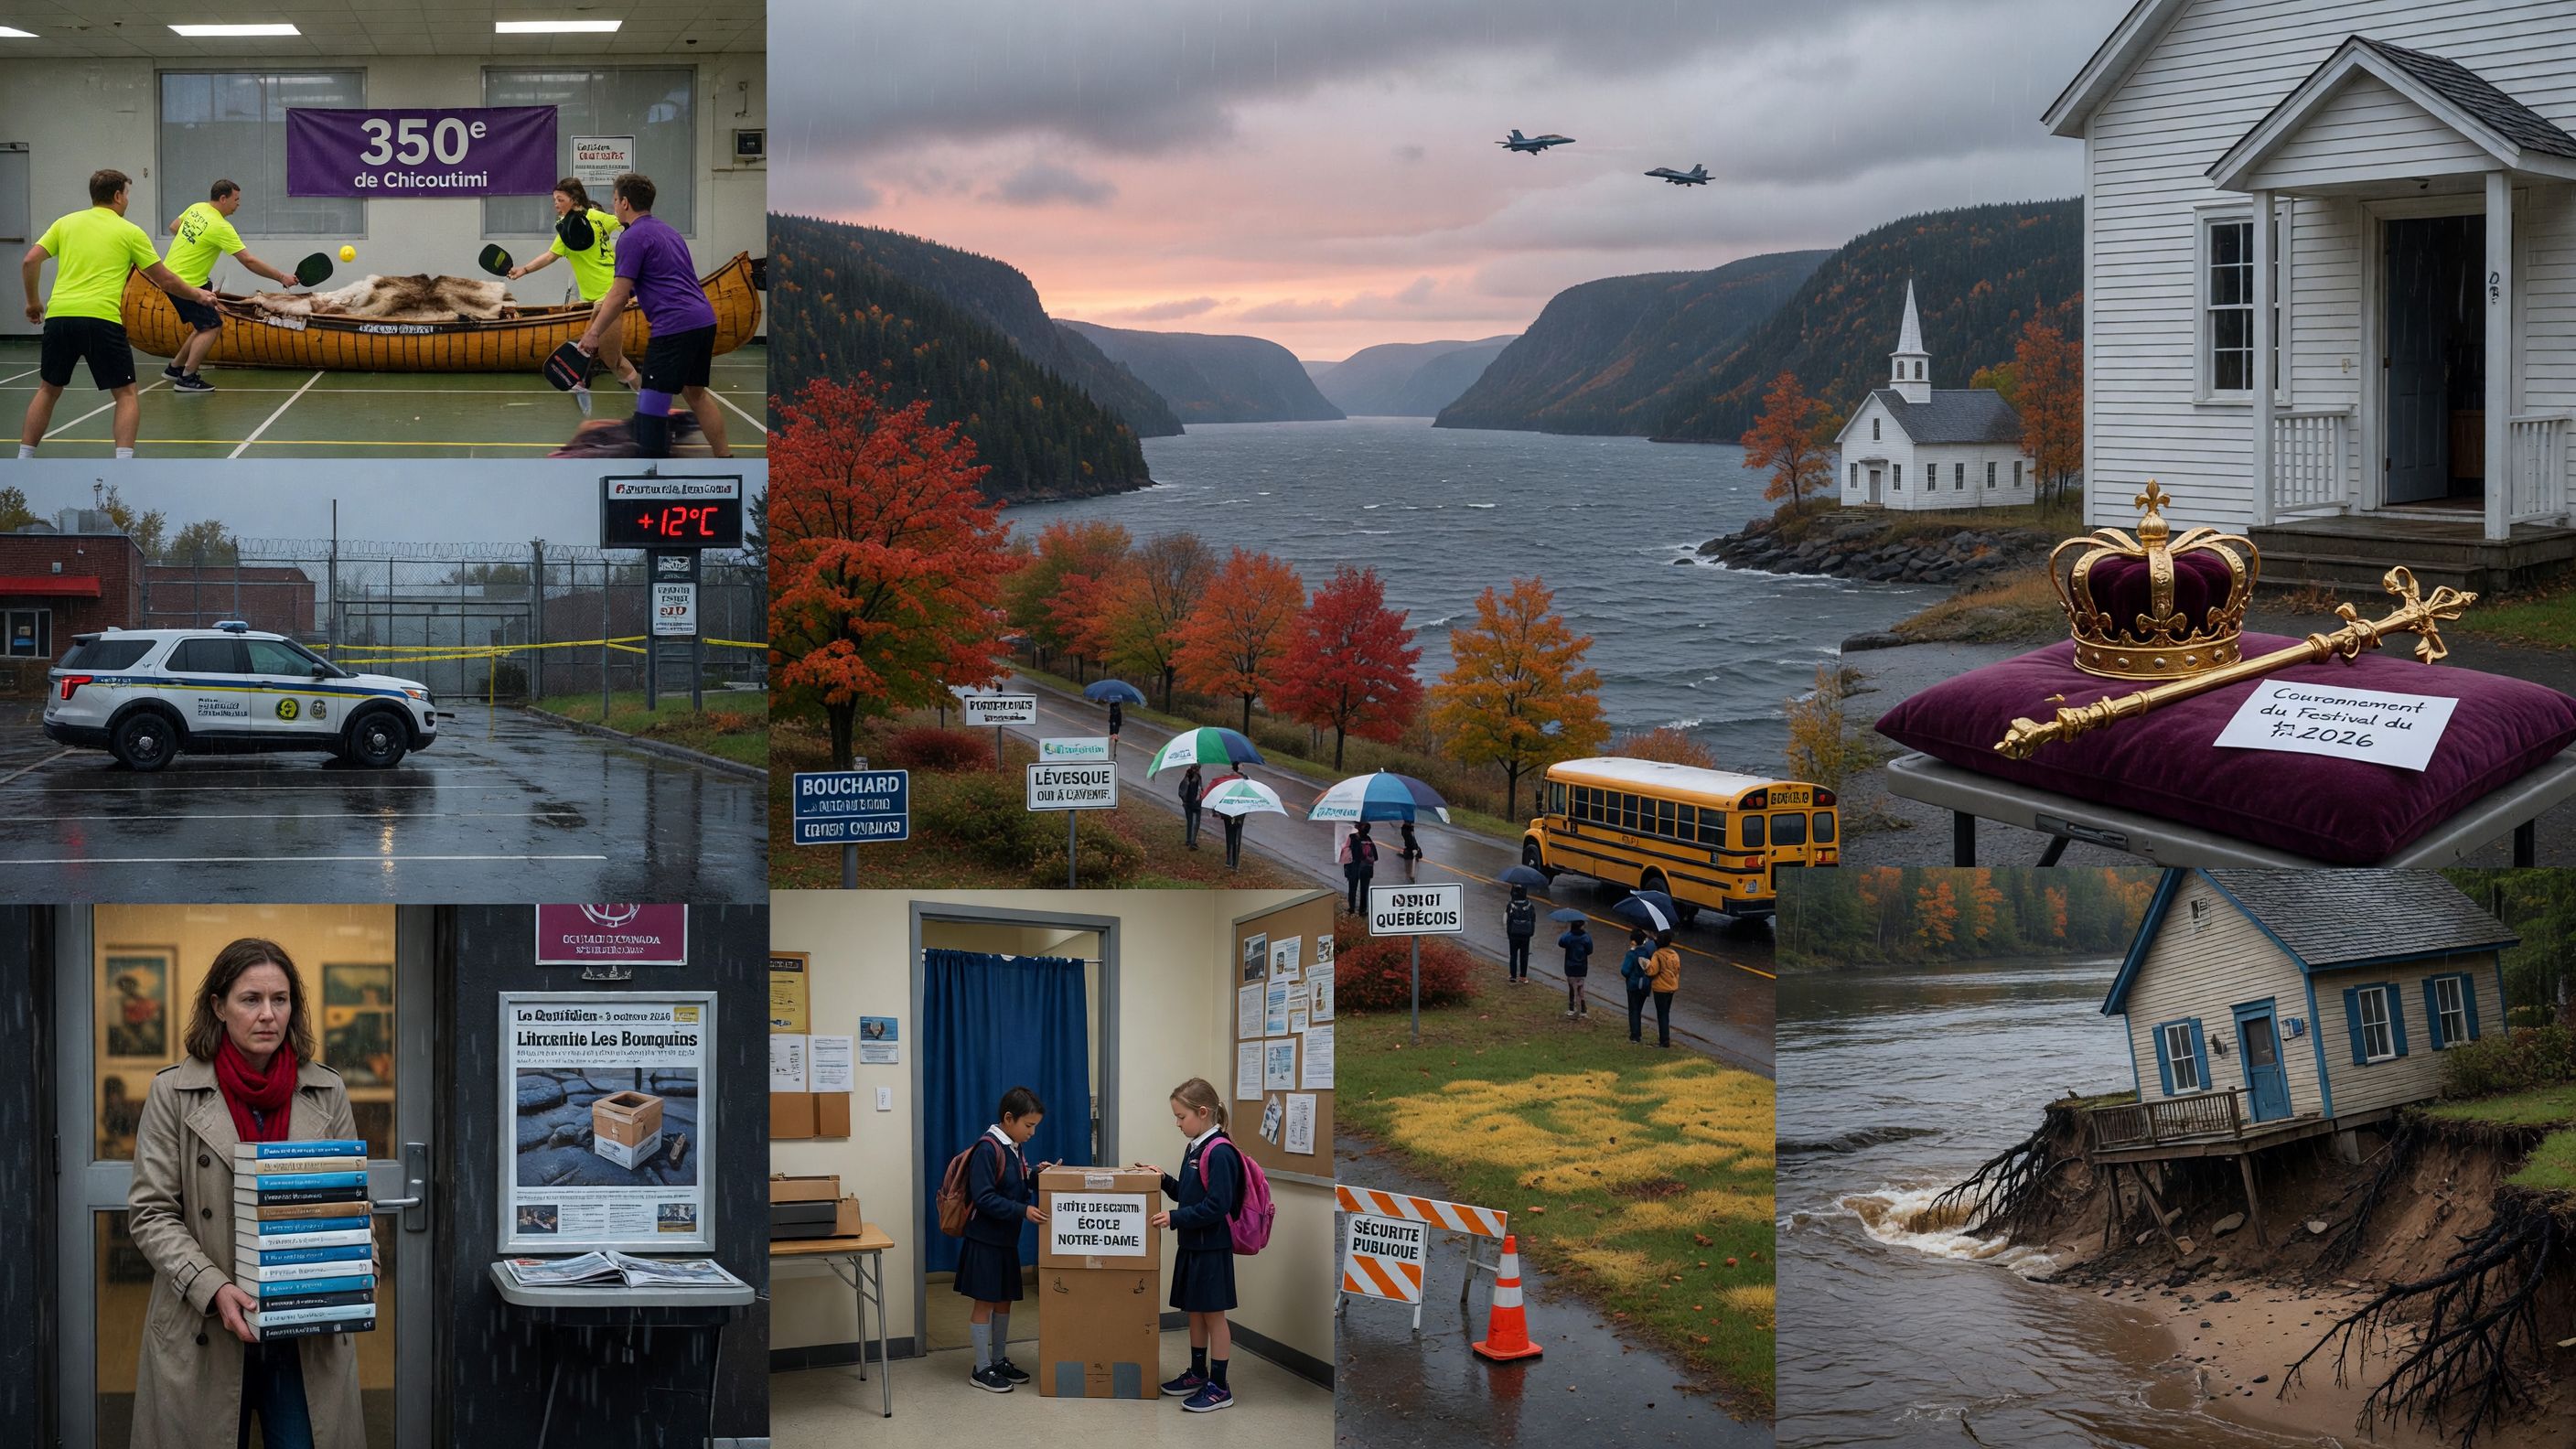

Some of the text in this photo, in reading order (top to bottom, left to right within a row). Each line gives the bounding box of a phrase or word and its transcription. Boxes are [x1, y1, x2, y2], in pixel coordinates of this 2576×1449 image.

[354, 171, 488, 188] de Chicoutimi
[2260, 703, 2413, 730] du Festival du
[2296, 727, 2374, 747] 2026
[1036, 767, 1111, 786] LÉVESQUE
[802, 776, 899, 796] BOUCHARD
[1037, 790, 1054, 801] OUI
[591, 1031, 617, 1046] Les
[1078, 1216, 1120, 1230] ÉCOLE
[1057, 1233, 1139, 1247] NOTRE-DAME
[1352, 1237, 1419, 1260] PUBLIQUE
